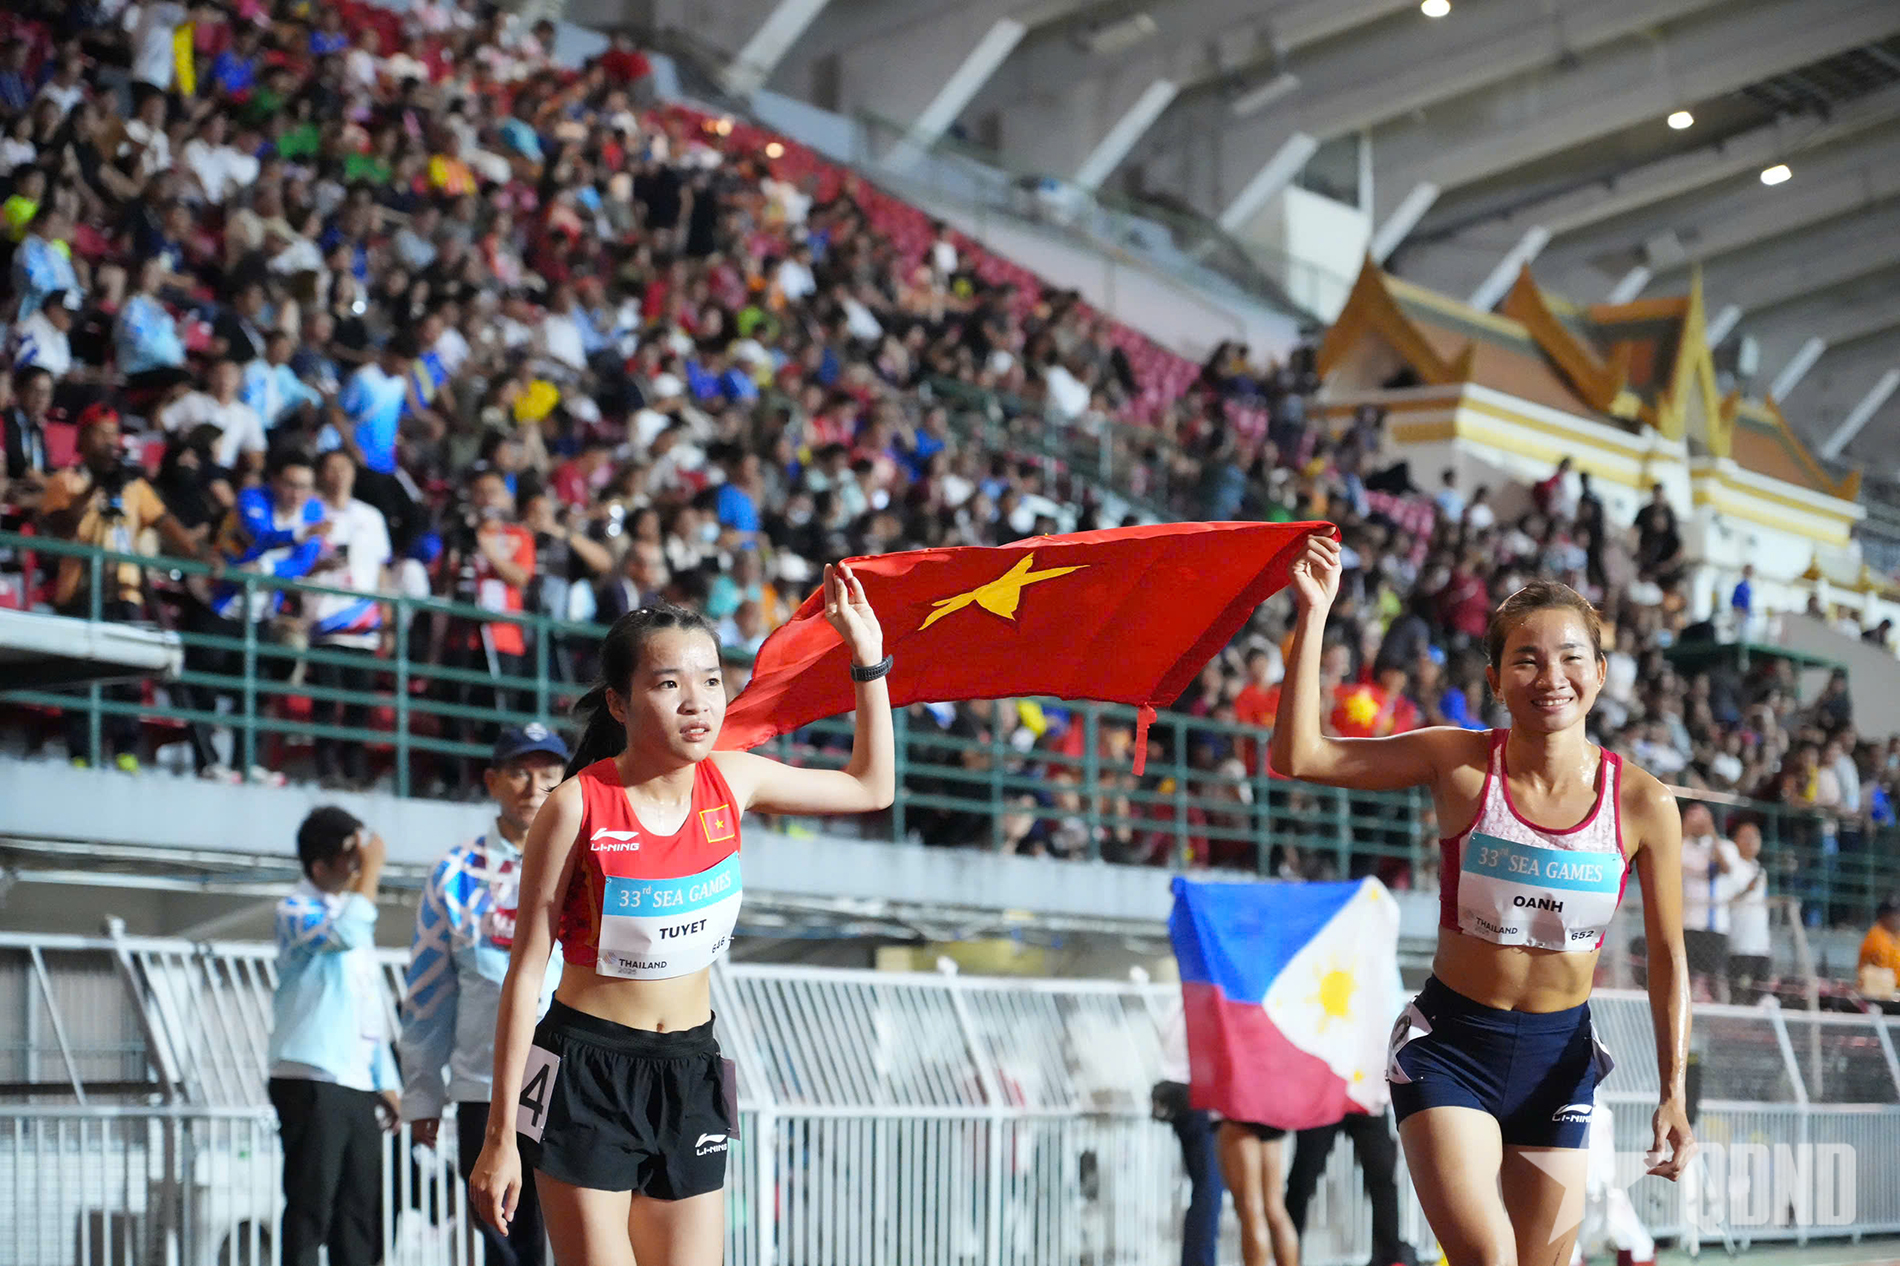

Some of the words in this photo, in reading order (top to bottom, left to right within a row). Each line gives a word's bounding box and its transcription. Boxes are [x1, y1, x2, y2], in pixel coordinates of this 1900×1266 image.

[590, 843, 639, 851] LI-NING
[1508, 855, 1540, 876] SEA
[1545, 861, 1604, 882] GAMES
[652, 888, 684, 908] SEA
[688, 870, 732, 902] GAMES
[1513, 895, 1564, 913] OANH
[659, 919, 707, 940] TUYET
[1476, 917, 1518, 935] THAILAND
[1571, 930, 1595, 941] 652
[619, 958, 668, 970] THAILAND
[519, 1063, 550, 1128] 4
